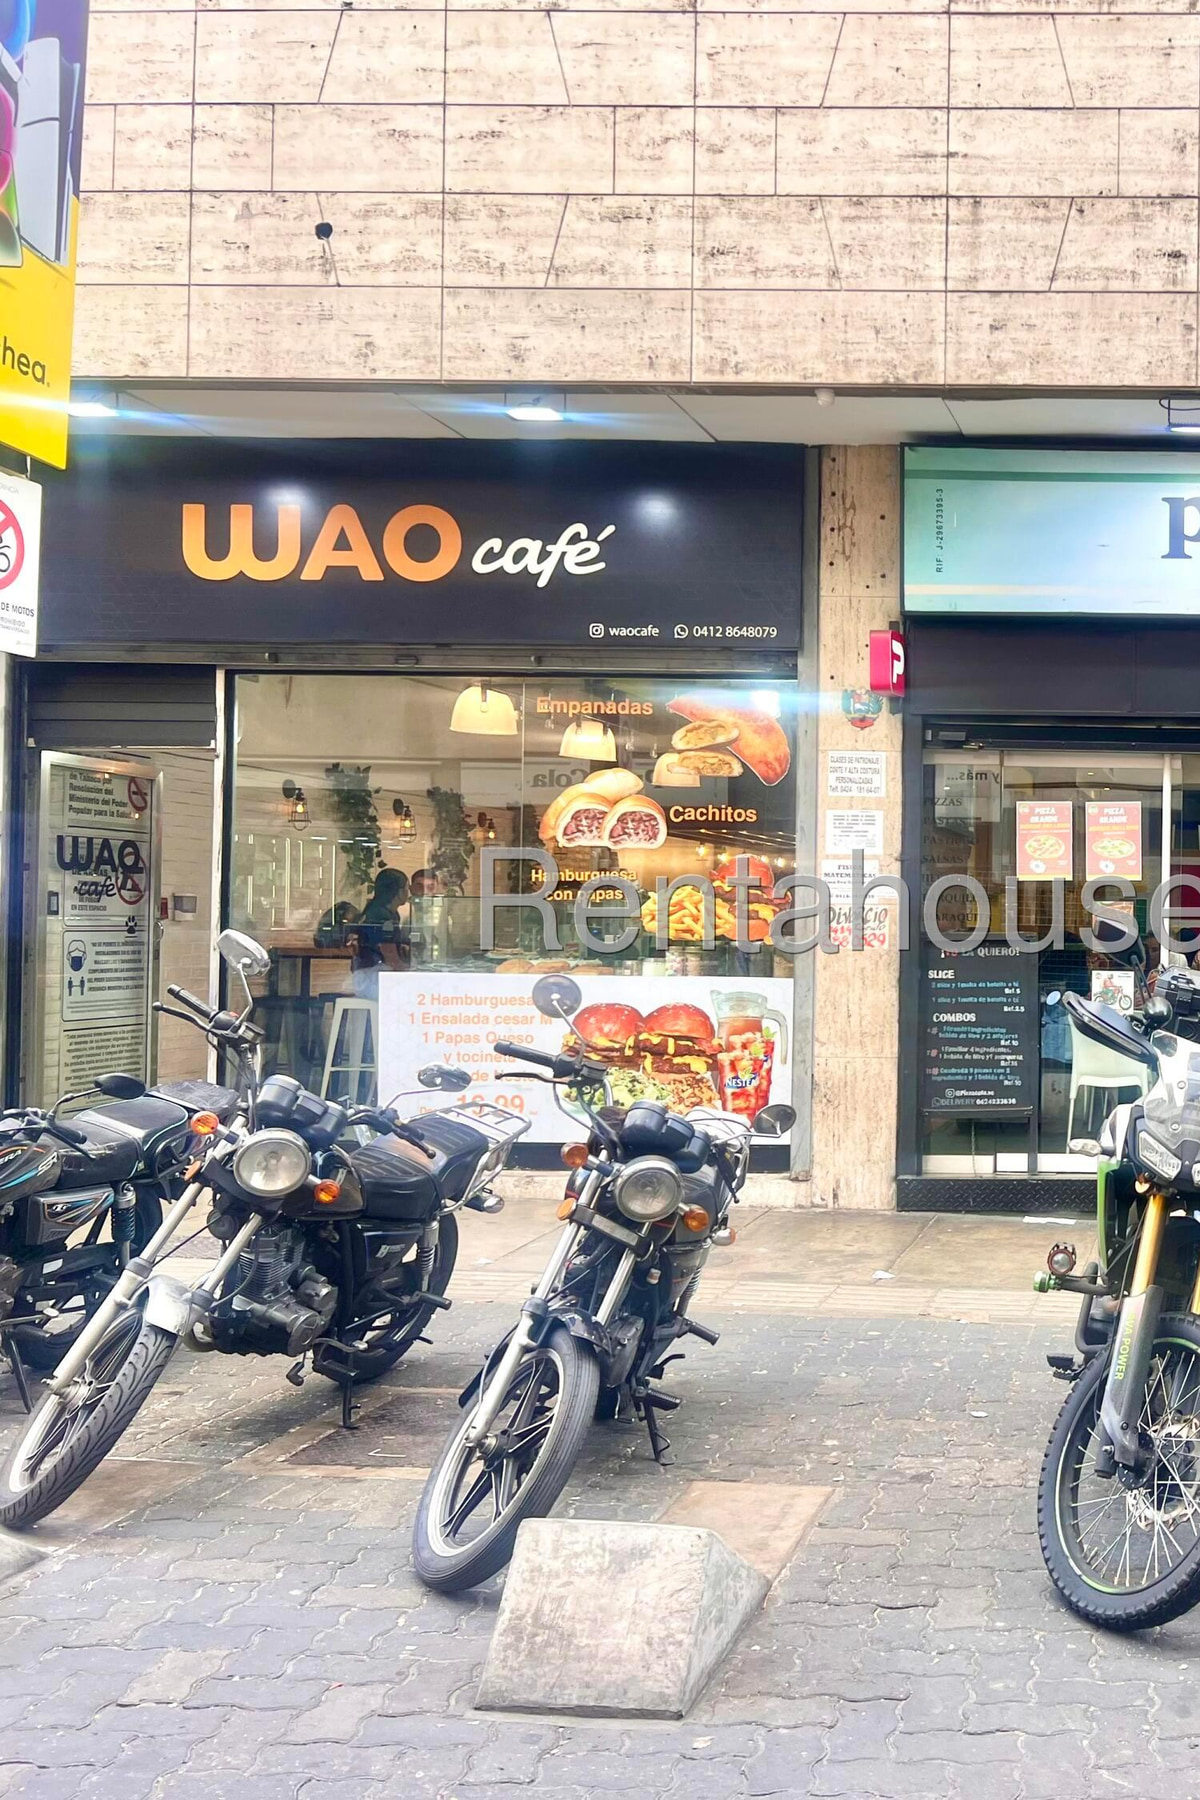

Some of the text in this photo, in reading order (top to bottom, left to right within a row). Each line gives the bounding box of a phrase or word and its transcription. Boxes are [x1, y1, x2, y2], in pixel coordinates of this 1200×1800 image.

[182, 504, 616, 588] WAO café
[11, 604, 35, 617] MOTOS
[608, 624, 777, 638] waocafe 0412 8648079
[536, 696, 654, 717] Empanadas
[669, 805, 758, 823] Cachitos
[531, 868, 637, 885] Hamburguesa
[545, 889, 573, 901] con
[928, 969, 955, 979] SLICE
[417, 993, 534, 1009] 2 Hamburguesa
[409, 1012, 415, 1024] 1
[422, 1012, 489, 1025] Ensalada
[494, 1014, 535, 1025] cesar
[933, 1012, 977, 1022] COMBOS
[422, 1031, 534, 1046] 1 Papas Queso
[1114, 1338, 1131, 1380] POWER
